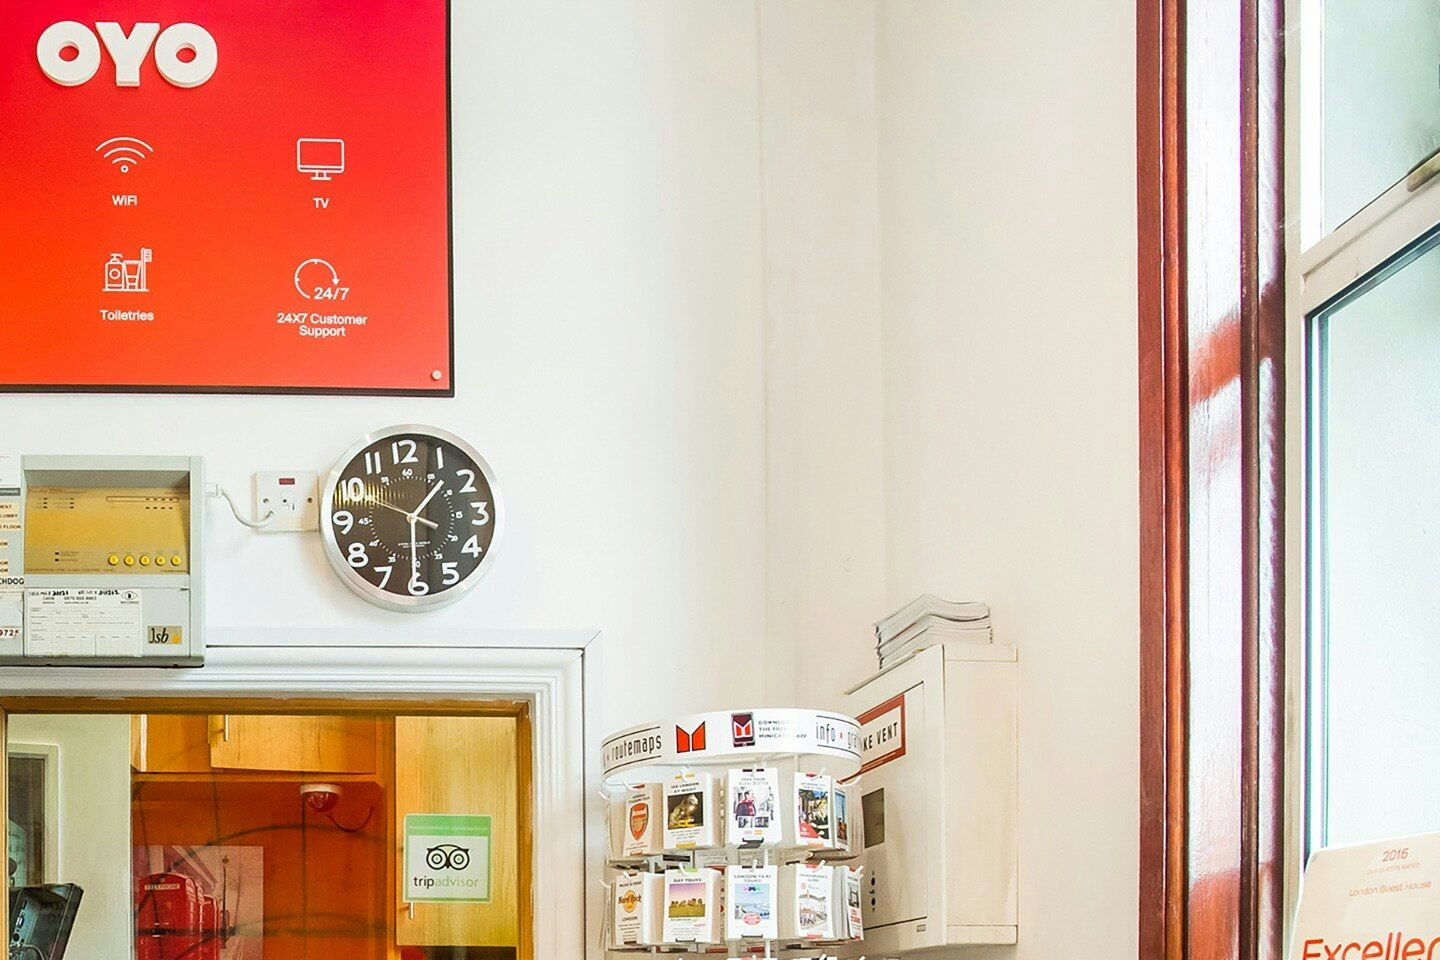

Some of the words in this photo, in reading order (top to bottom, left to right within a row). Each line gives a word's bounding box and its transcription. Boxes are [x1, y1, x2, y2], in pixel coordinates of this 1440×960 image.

[37, 21, 217, 87] OYO
[314, 197, 328, 208] TV
[314, 287, 349, 300] 24/7
[100, 309, 153, 321] Toiletries
[277, 313, 308, 325] 24X7
[310, 313, 367, 325] Customer
[299, 326, 345, 338] Support
[365, 451, 381, 474] 11
[392, 440, 418, 465] 12
[436, 447, 444, 468] 1
[341, 477, 364, 501] 10
[456, 469, 477, 492] 2
[333, 511, 354, 535] 9
[471, 502, 489, 526] 3
[348, 543, 369, 567] 8
[461, 535, 482, 558] 4
[374, 566, 392, 589] 7
[408, 572, 429, 596] 6
[441, 562, 459, 585] 5
[816, 722, 835, 745] info
[877, 722, 898, 745] VENT
[612, 735, 662, 760] routemaps
[1382, 848, 1409, 862] 2016
[413, 875, 480, 889] tripadvisor
[1349, 885, 1378, 897] London
[1379, 882, 1403, 895] Guest
